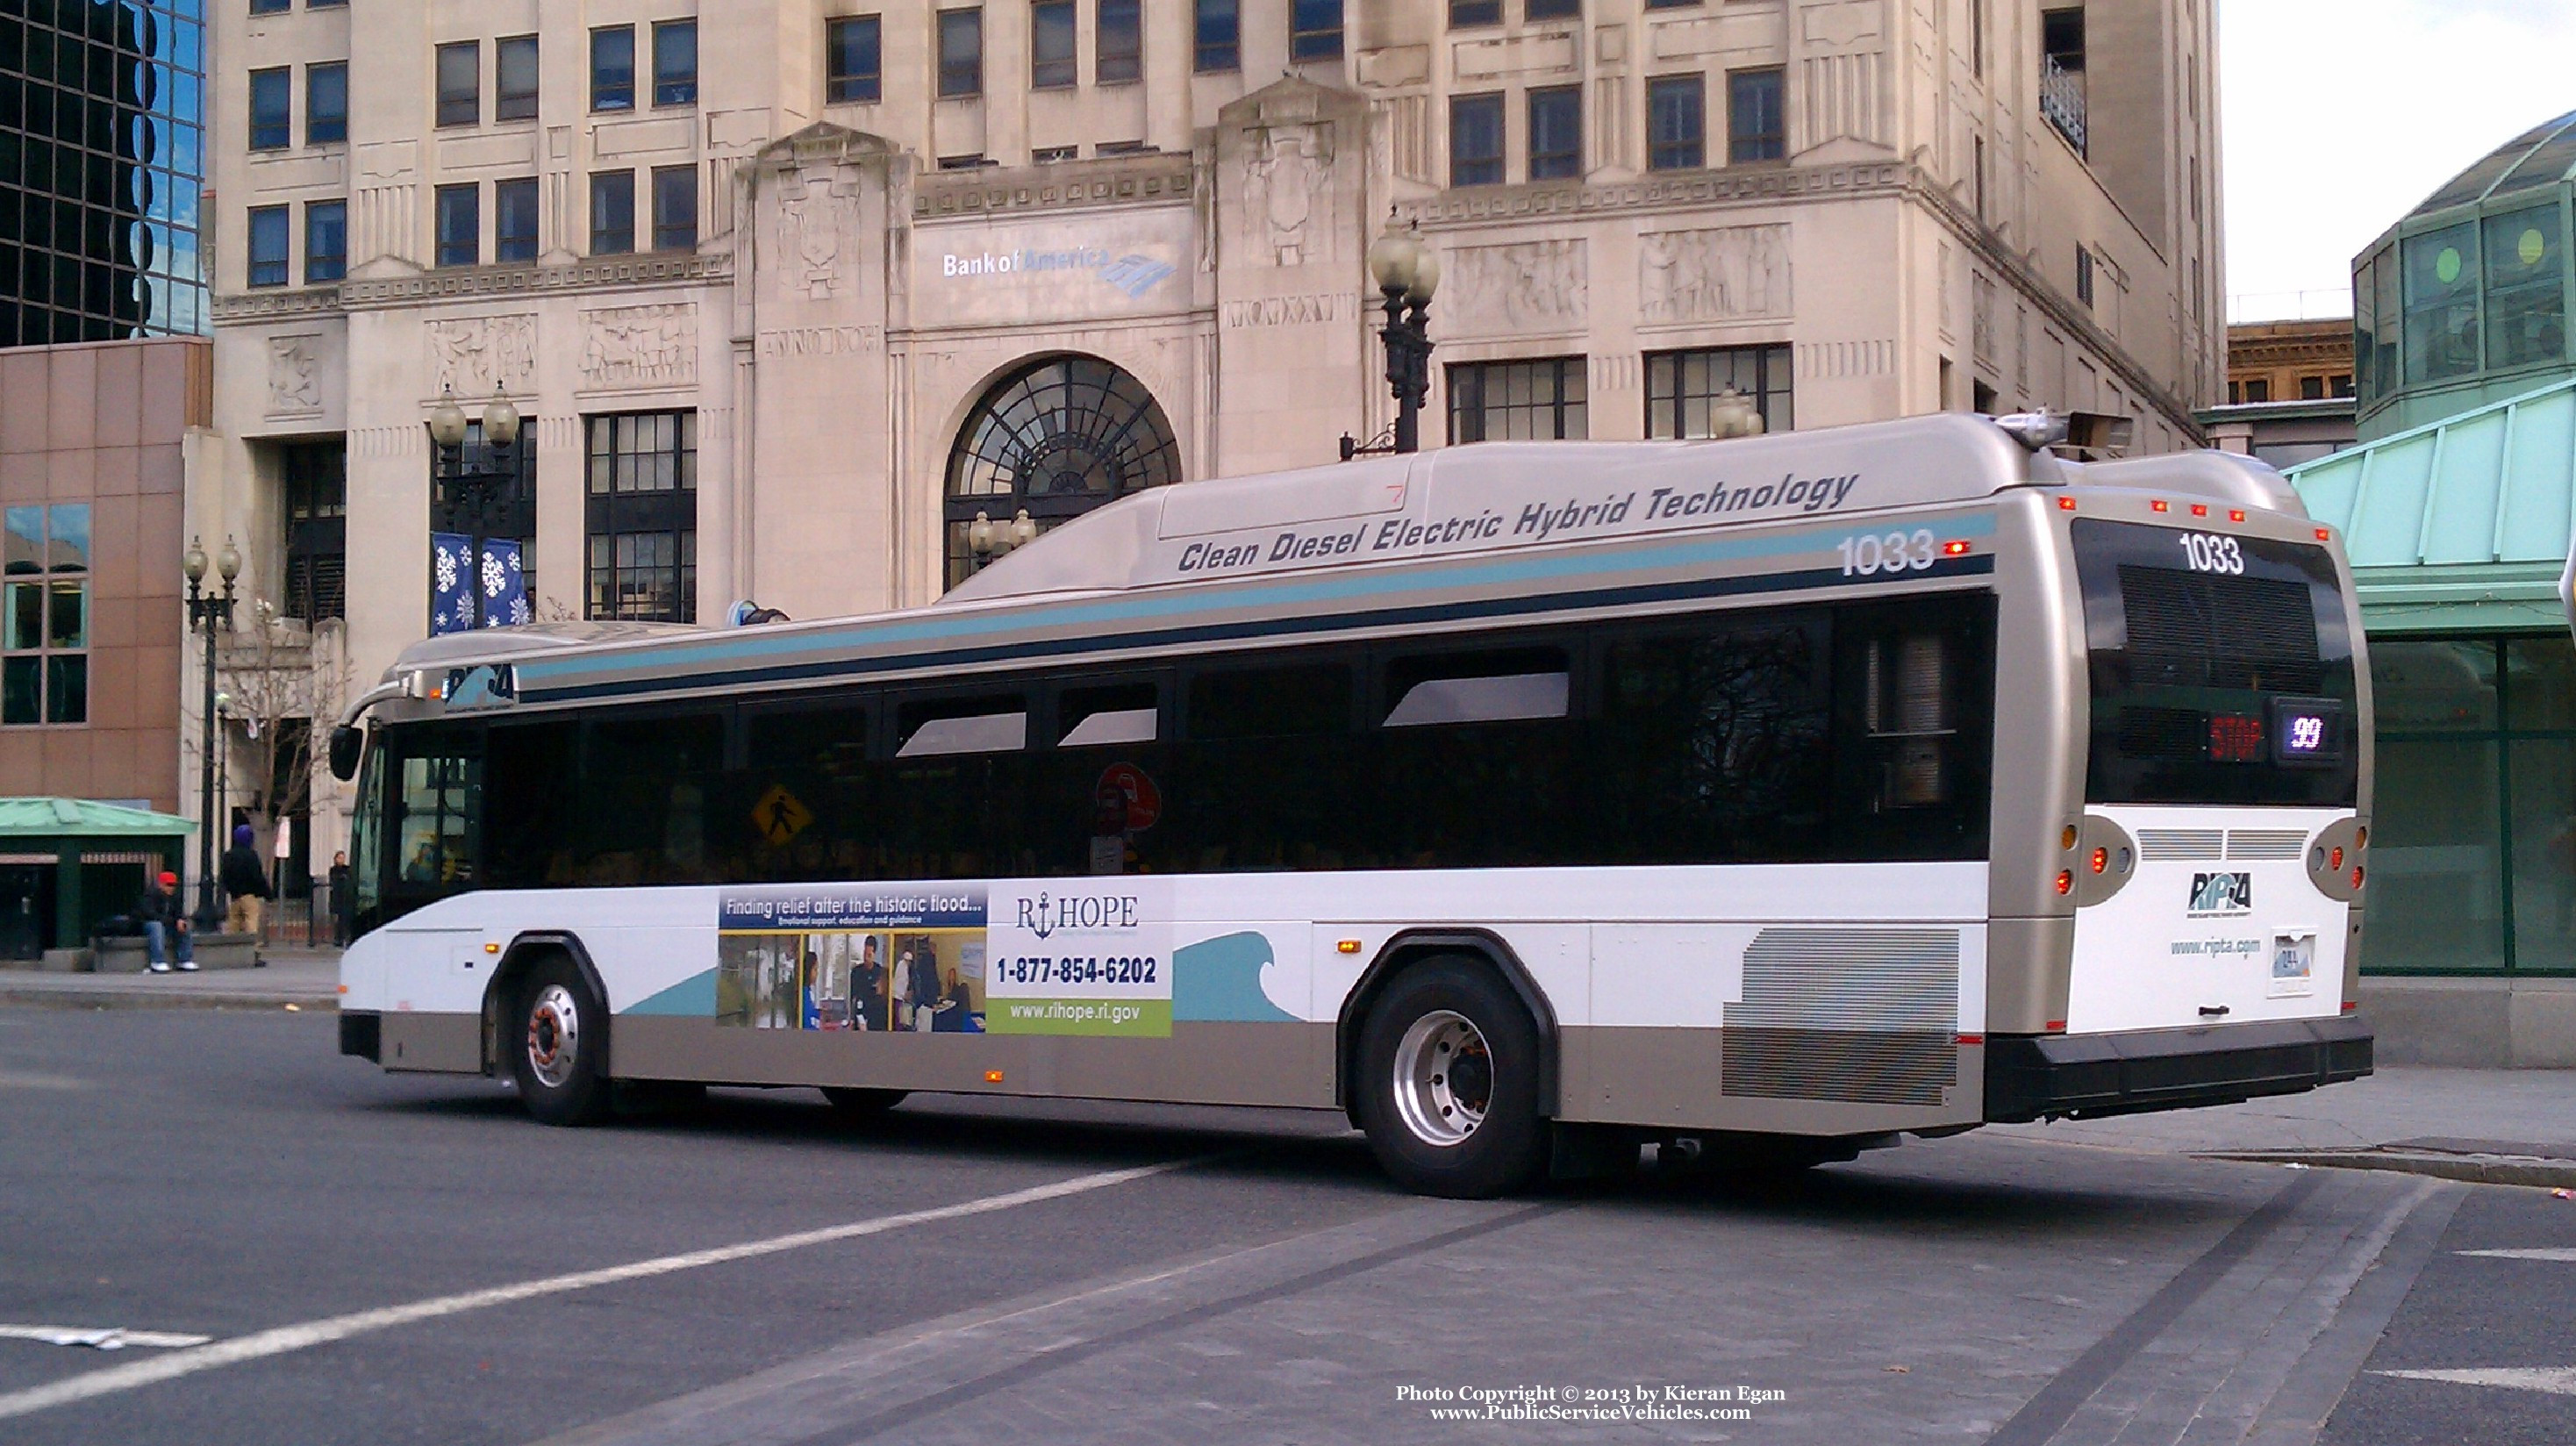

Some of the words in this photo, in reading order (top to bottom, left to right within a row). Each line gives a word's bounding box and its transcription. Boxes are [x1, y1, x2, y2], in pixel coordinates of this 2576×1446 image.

[943, 252, 995, 277] Bank
[998, 248, 1020, 272] of
[1023, 246, 1109, 271] America
[1177, 541, 1259, 572] Clean
[1268, 523, 1367, 562] Diesel
[1373, 509, 1504, 551] Electric
[1513, 492, 1635, 539] Hybrid
[1646, 473, 1858, 519] Technology
[1837, 529, 1935, 578] 1033
[2180, 532, 2245, 576] 1033
[2292, 717, 2323, 748] 99
[726, 898, 772, 918] Finding
[776, 898, 811, 913] relief
[814, 898, 846, 913] after
[849, 897, 871, 913] the
[875, 895, 926, 912] historic
[930, 894, 982, 912] flood...
[2171, 936, 2261, 959] www.ripta.com
[998, 956, 1156, 984] 1-877-854-6202
[1011, 1002, 1140, 1025] www.rihope.ri.gov
